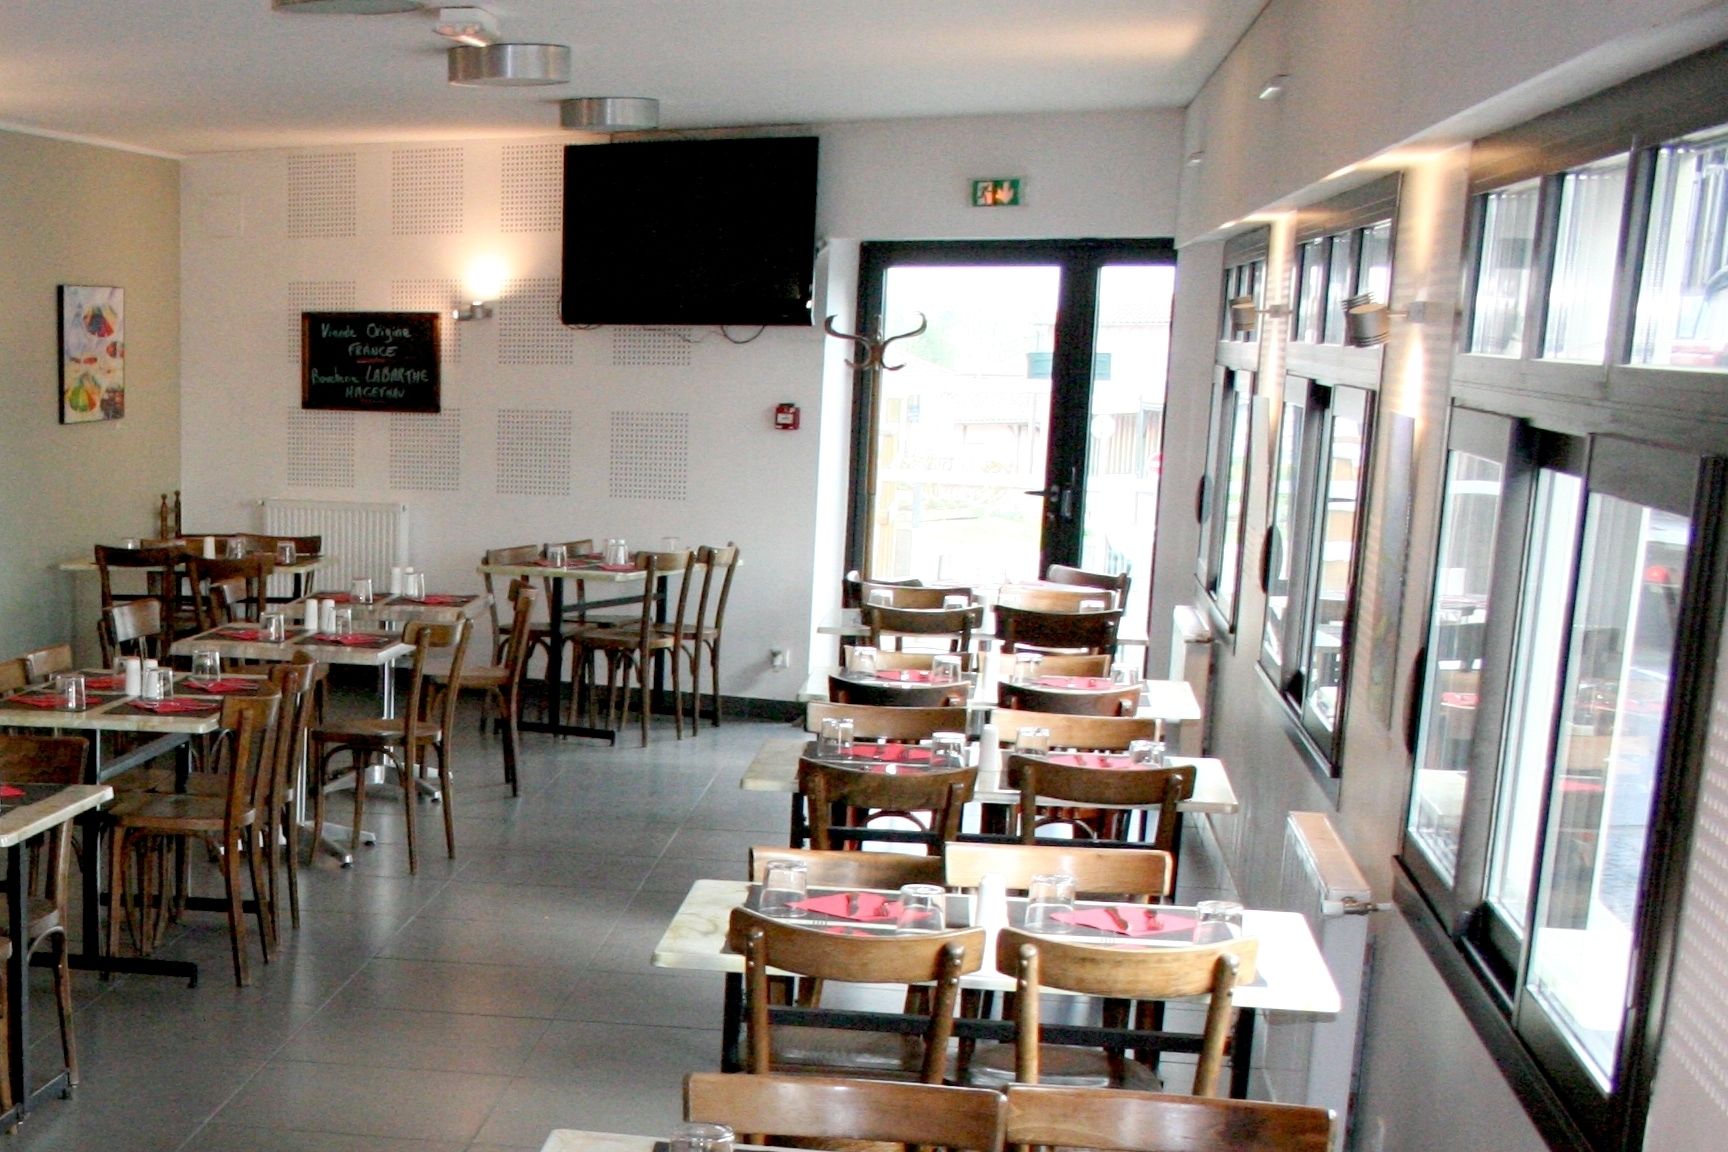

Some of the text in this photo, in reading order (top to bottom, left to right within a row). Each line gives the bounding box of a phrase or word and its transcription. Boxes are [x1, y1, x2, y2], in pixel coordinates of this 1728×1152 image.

[367, 323, 412, 342] Origine
[348, 343, 398, 357] FRANCE
[366, 365, 429, 385] LABARTHE
